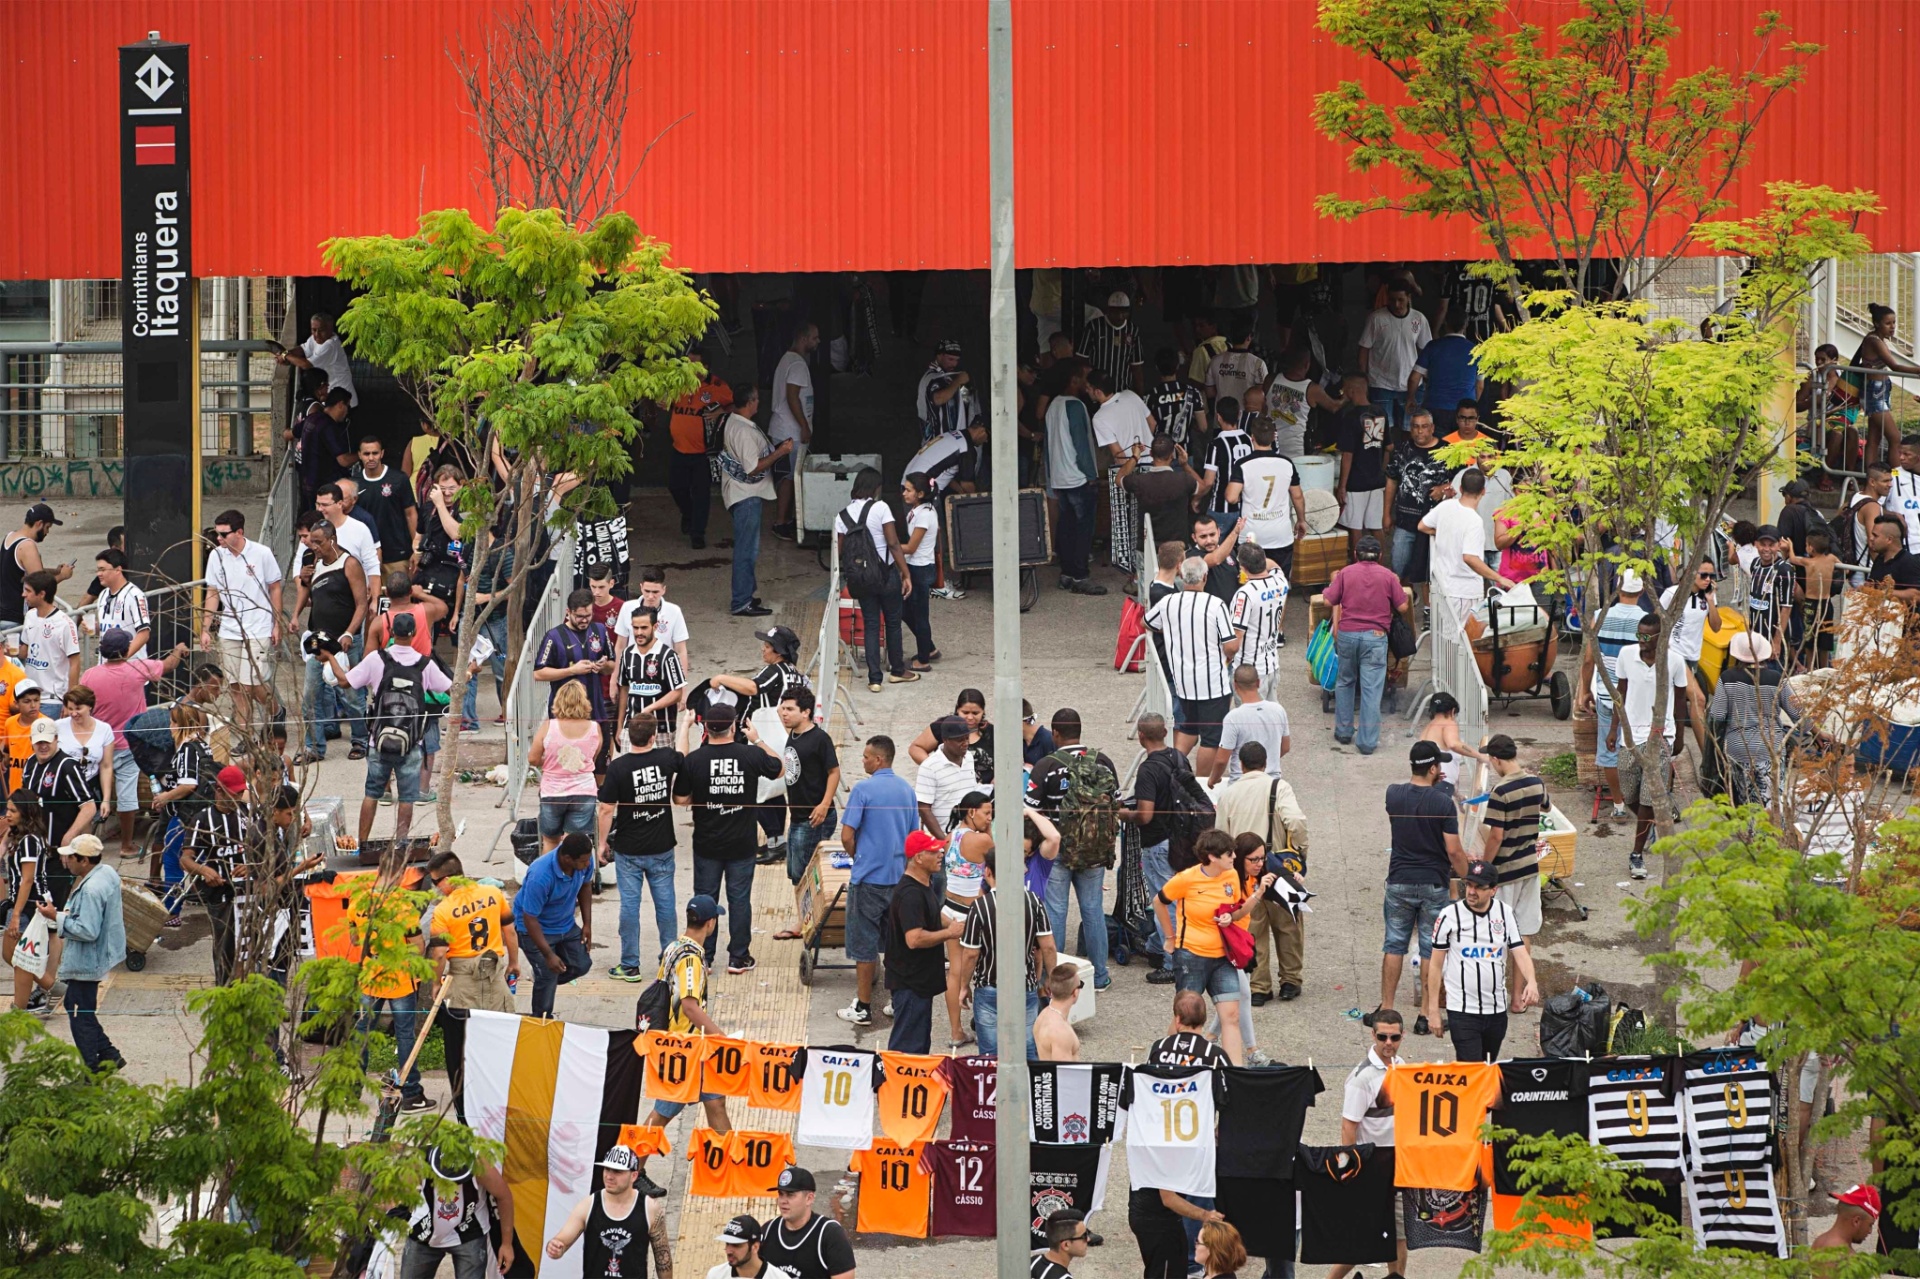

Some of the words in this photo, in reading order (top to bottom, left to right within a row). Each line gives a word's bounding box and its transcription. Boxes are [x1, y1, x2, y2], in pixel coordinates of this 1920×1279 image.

[149, 191, 186, 336] Itaquera
[132, 232, 149, 337] Corinthians
[1463, 283, 1488, 314] 10
[1158, 391, 1185, 405] CAIX
[1262, 475, 1276, 509] 7
[1261, 586, 1289, 602] CAIXA
[632, 683, 661, 691] batavo
[632, 765, 662, 787] FIEL
[709, 758, 741, 776] FIEL
[634, 780, 668, 796] TORCIDA
[709, 785, 745, 795] IBITINGA
[710, 776, 745, 785] TORCIDA
[634, 788, 668, 804] IBITINGA
[452, 896, 497, 919] CAIXA
[468, 916, 489, 952] 8
[1461, 946, 1503, 958] CAIXA
[655, 1038, 693, 1049] CAIXA
[658, 1051, 688, 1086] 10
[708, 1046, 742, 1076] 10
[822, 1055, 861, 1068] CAIXA
[967, 1058, 997, 1068] CAIX
[1159, 1051, 1204, 1067] CAIXA
[1702, 1058, 1758, 1075] CAIXA
[762, 1060, 792, 1094] 10
[1413, 1072, 1468, 1087] CAIXA
[1606, 1067, 1663, 1082] CAIXA
[823, 1069, 853, 1107] 10
[1034, 1082, 1042, 1098] POR
[1152, 1081, 1199, 1094] CAIXA
[901, 1082, 928, 1120] 10
[1042, 1072, 1053, 1130] CORINTHIANS
[1724, 1081, 1748, 1129] 9
[1035, 1098, 1043, 1127] LOUCOS
[1160, 1098, 1199, 1142] 10
[1419, 1089, 1459, 1138] 10
[1626, 1089, 1650, 1138] 9
[702, 1139, 724, 1170] 10
[744, 1139, 772, 1168] 10
[875, 1147, 915, 1157] CAIXA
[880, 1159, 910, 1192] 10
[955, 1156, 984, 1192] 12
[955, 1194, 983, 1206] CÁSSIO
[1724, 1170, 1748, 1209] 9
[604, 1270, 623, 1278] FIEL
